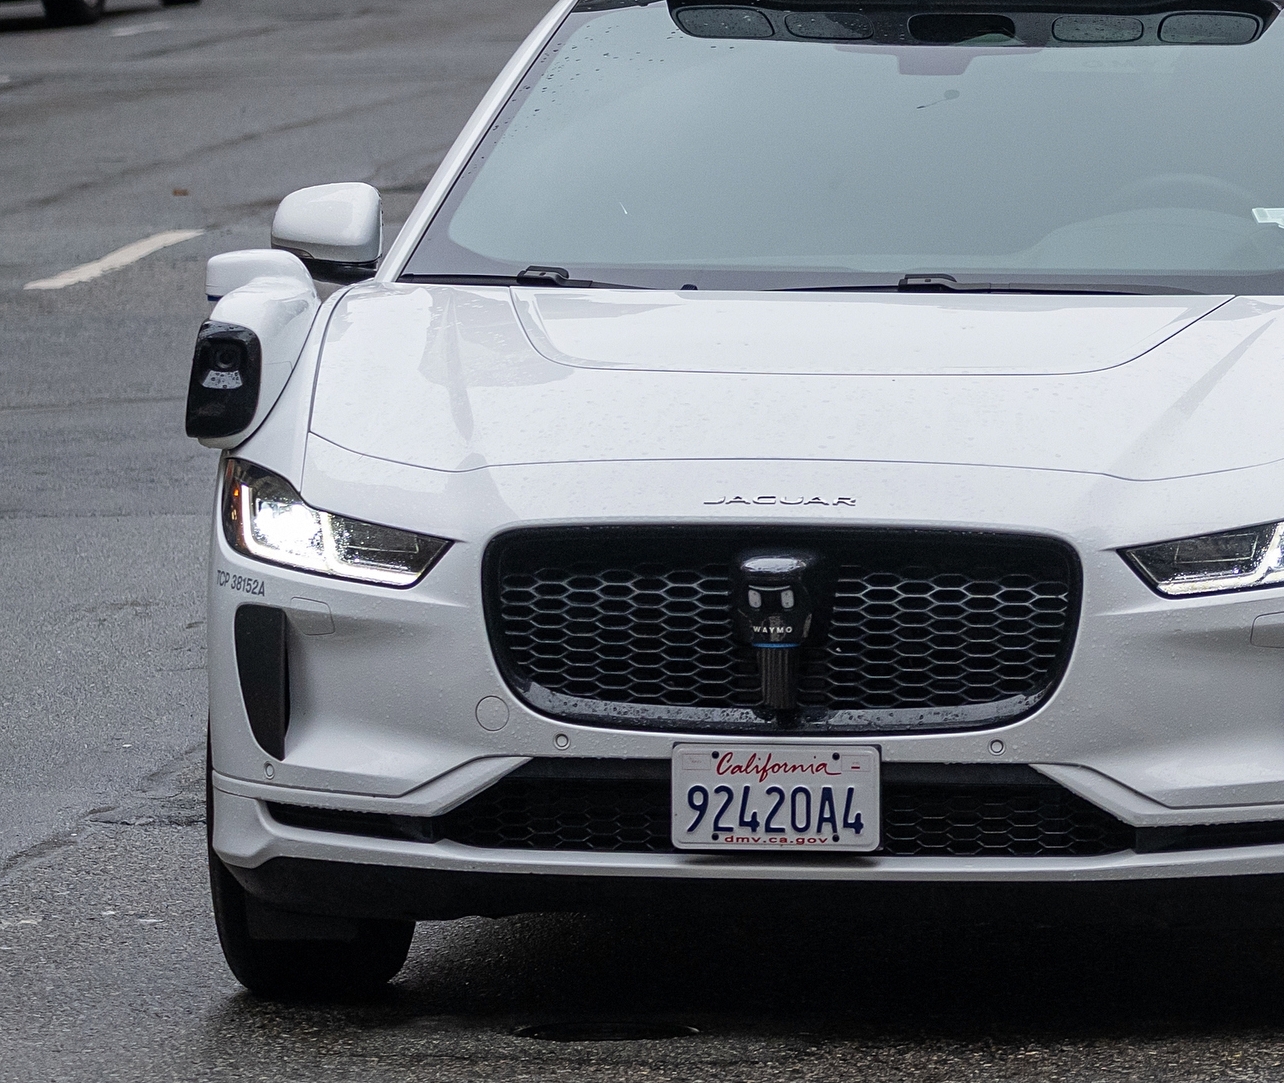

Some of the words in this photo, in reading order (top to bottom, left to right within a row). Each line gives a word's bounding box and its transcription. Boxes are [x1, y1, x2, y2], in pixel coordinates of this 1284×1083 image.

[703, 495, 857, 507] JAGUAR
[216, 569, 231, 587] TCP
[230, 574, 266, 597] 38152A
[752, 625, 794, 634] WAYMO
[715, 751, 843, 783] California
[686, 784, 865, 835] 92420A4
[724, 834, 829, 846] dmv.ca.gov
